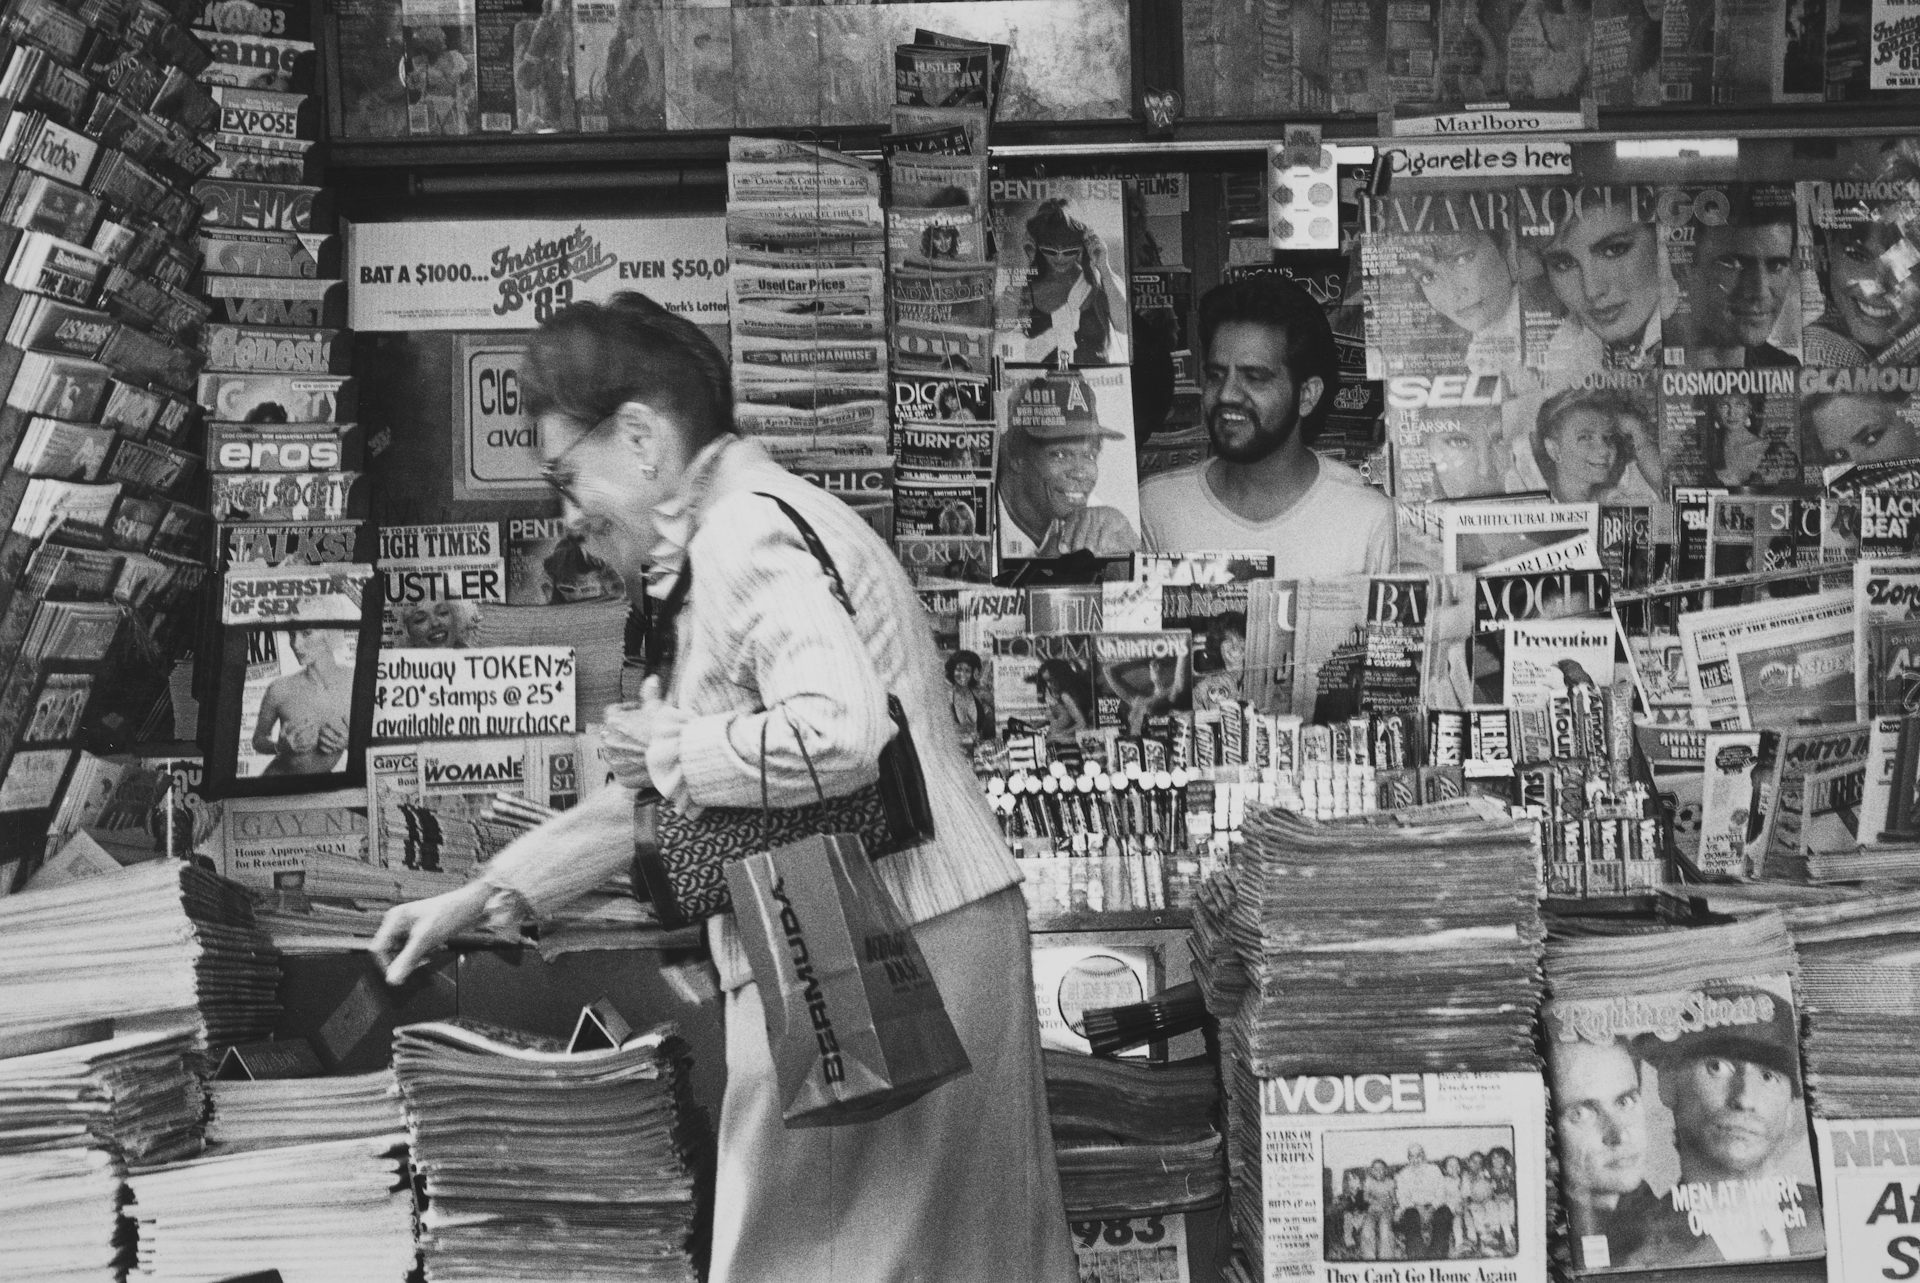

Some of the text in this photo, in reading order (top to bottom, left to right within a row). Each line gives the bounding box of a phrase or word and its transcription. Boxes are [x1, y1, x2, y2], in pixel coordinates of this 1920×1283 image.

[222, 109, 296, 134] EXPOSE
[1435, 114, 1540, 133] Marlboro
[33, 131, 80, 173] Forbes
[1389, 146, 1571, 176] Cigarettes here
[1138, 178, 1179, 196] FILMS
[1657, 188, 1731, 228] GQ
[490, 223, 593, 280] Instant
[360, 265, 394, 284] BAT
[398, 265, 411, 284] A
[415, 261, 490, 286] $1000...
[619, 260, 665, 279] EVEN
[758, 279, 846, 291] Used Car Prices
[780, 352, 872, 363] MERCHANDISE
[479, 368, 523, 416] CIG
[1662, 370, 1795, 396] COSMOPOLITAN
[1800, 367, 1920, 395] GLAMOU
[905, 432, 990, 449] TURN-ONS
[219, 442, 339, 469] eros
[1457, 511, 1545, 528] ARCHITECTURAL
[1551, 510, 1592, 525] DIGEST
[1861, 517, 1910, 539] BEAT
[380, 531, 491, 559] IGH TIMES
[384, 569, 500, 603] USTLER
[230, 599, 299, 617] OF SEX
[1512, 629, 1609, 649] Prevention
[1746, 621, 1767, 633] THE
[376, 656, 456, 685] subway
[464, 654, 551, 680] TOKEN
[428, 685, 498, 713] stamps
[503, 686, 522, 706] @
[376, 711, 455, 738] available
[459, 715, 481, 735] on
[373, 757, 401, 775] Gay
[240, 811, 306, 835] GAY
[235, 844, 310, 858] House Approv
[235, 857, 299, 869] for Research
[771, 876, 846, 1085] BERMUDA
[1670, 1181, 1713, 1212] MEN
[1326, 1267, 1360, 1283] They
[1405, 1267, 1426, 1283] Go
